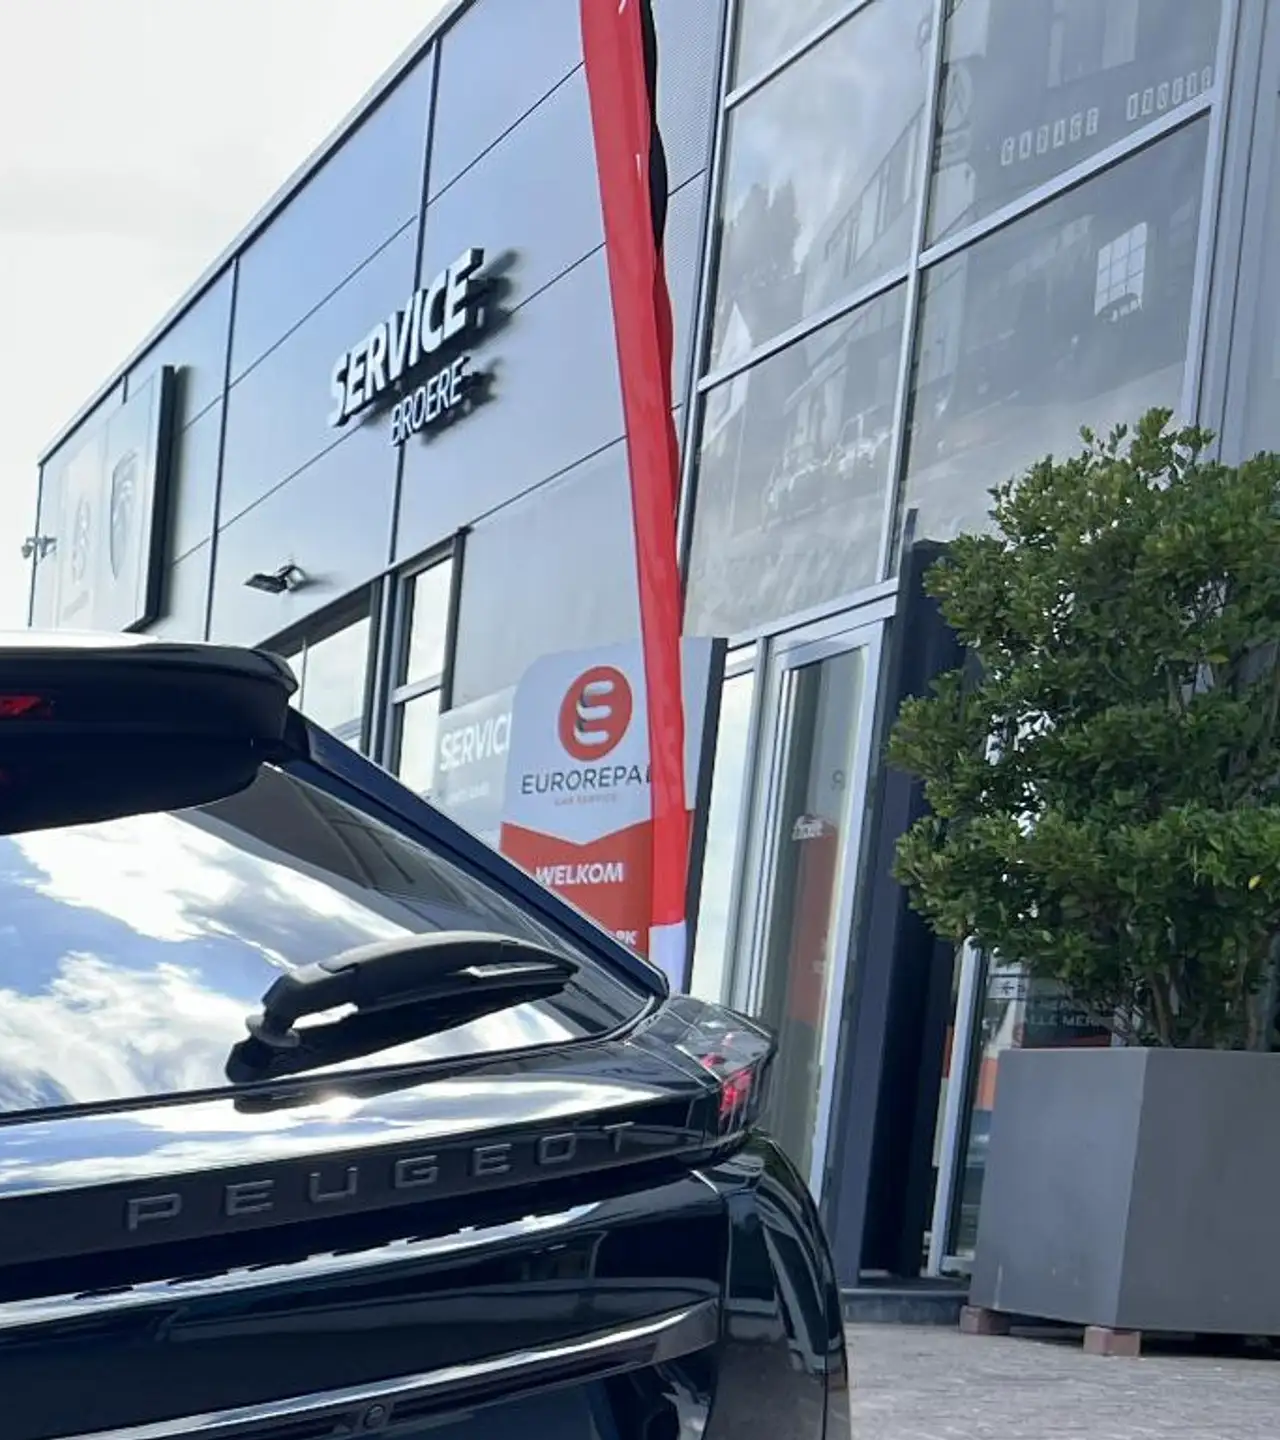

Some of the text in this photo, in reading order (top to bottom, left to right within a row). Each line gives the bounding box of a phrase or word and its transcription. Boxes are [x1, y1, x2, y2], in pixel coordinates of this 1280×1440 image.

[327, 247, 485, 428] SERVICE
[390, 356, 471, 447] BROERE
[439, 711, 512, 771] SERVIC
[535, 861, 624, 887] WELKOM
[124, 1119, 635, 1232] PEUGEOT
